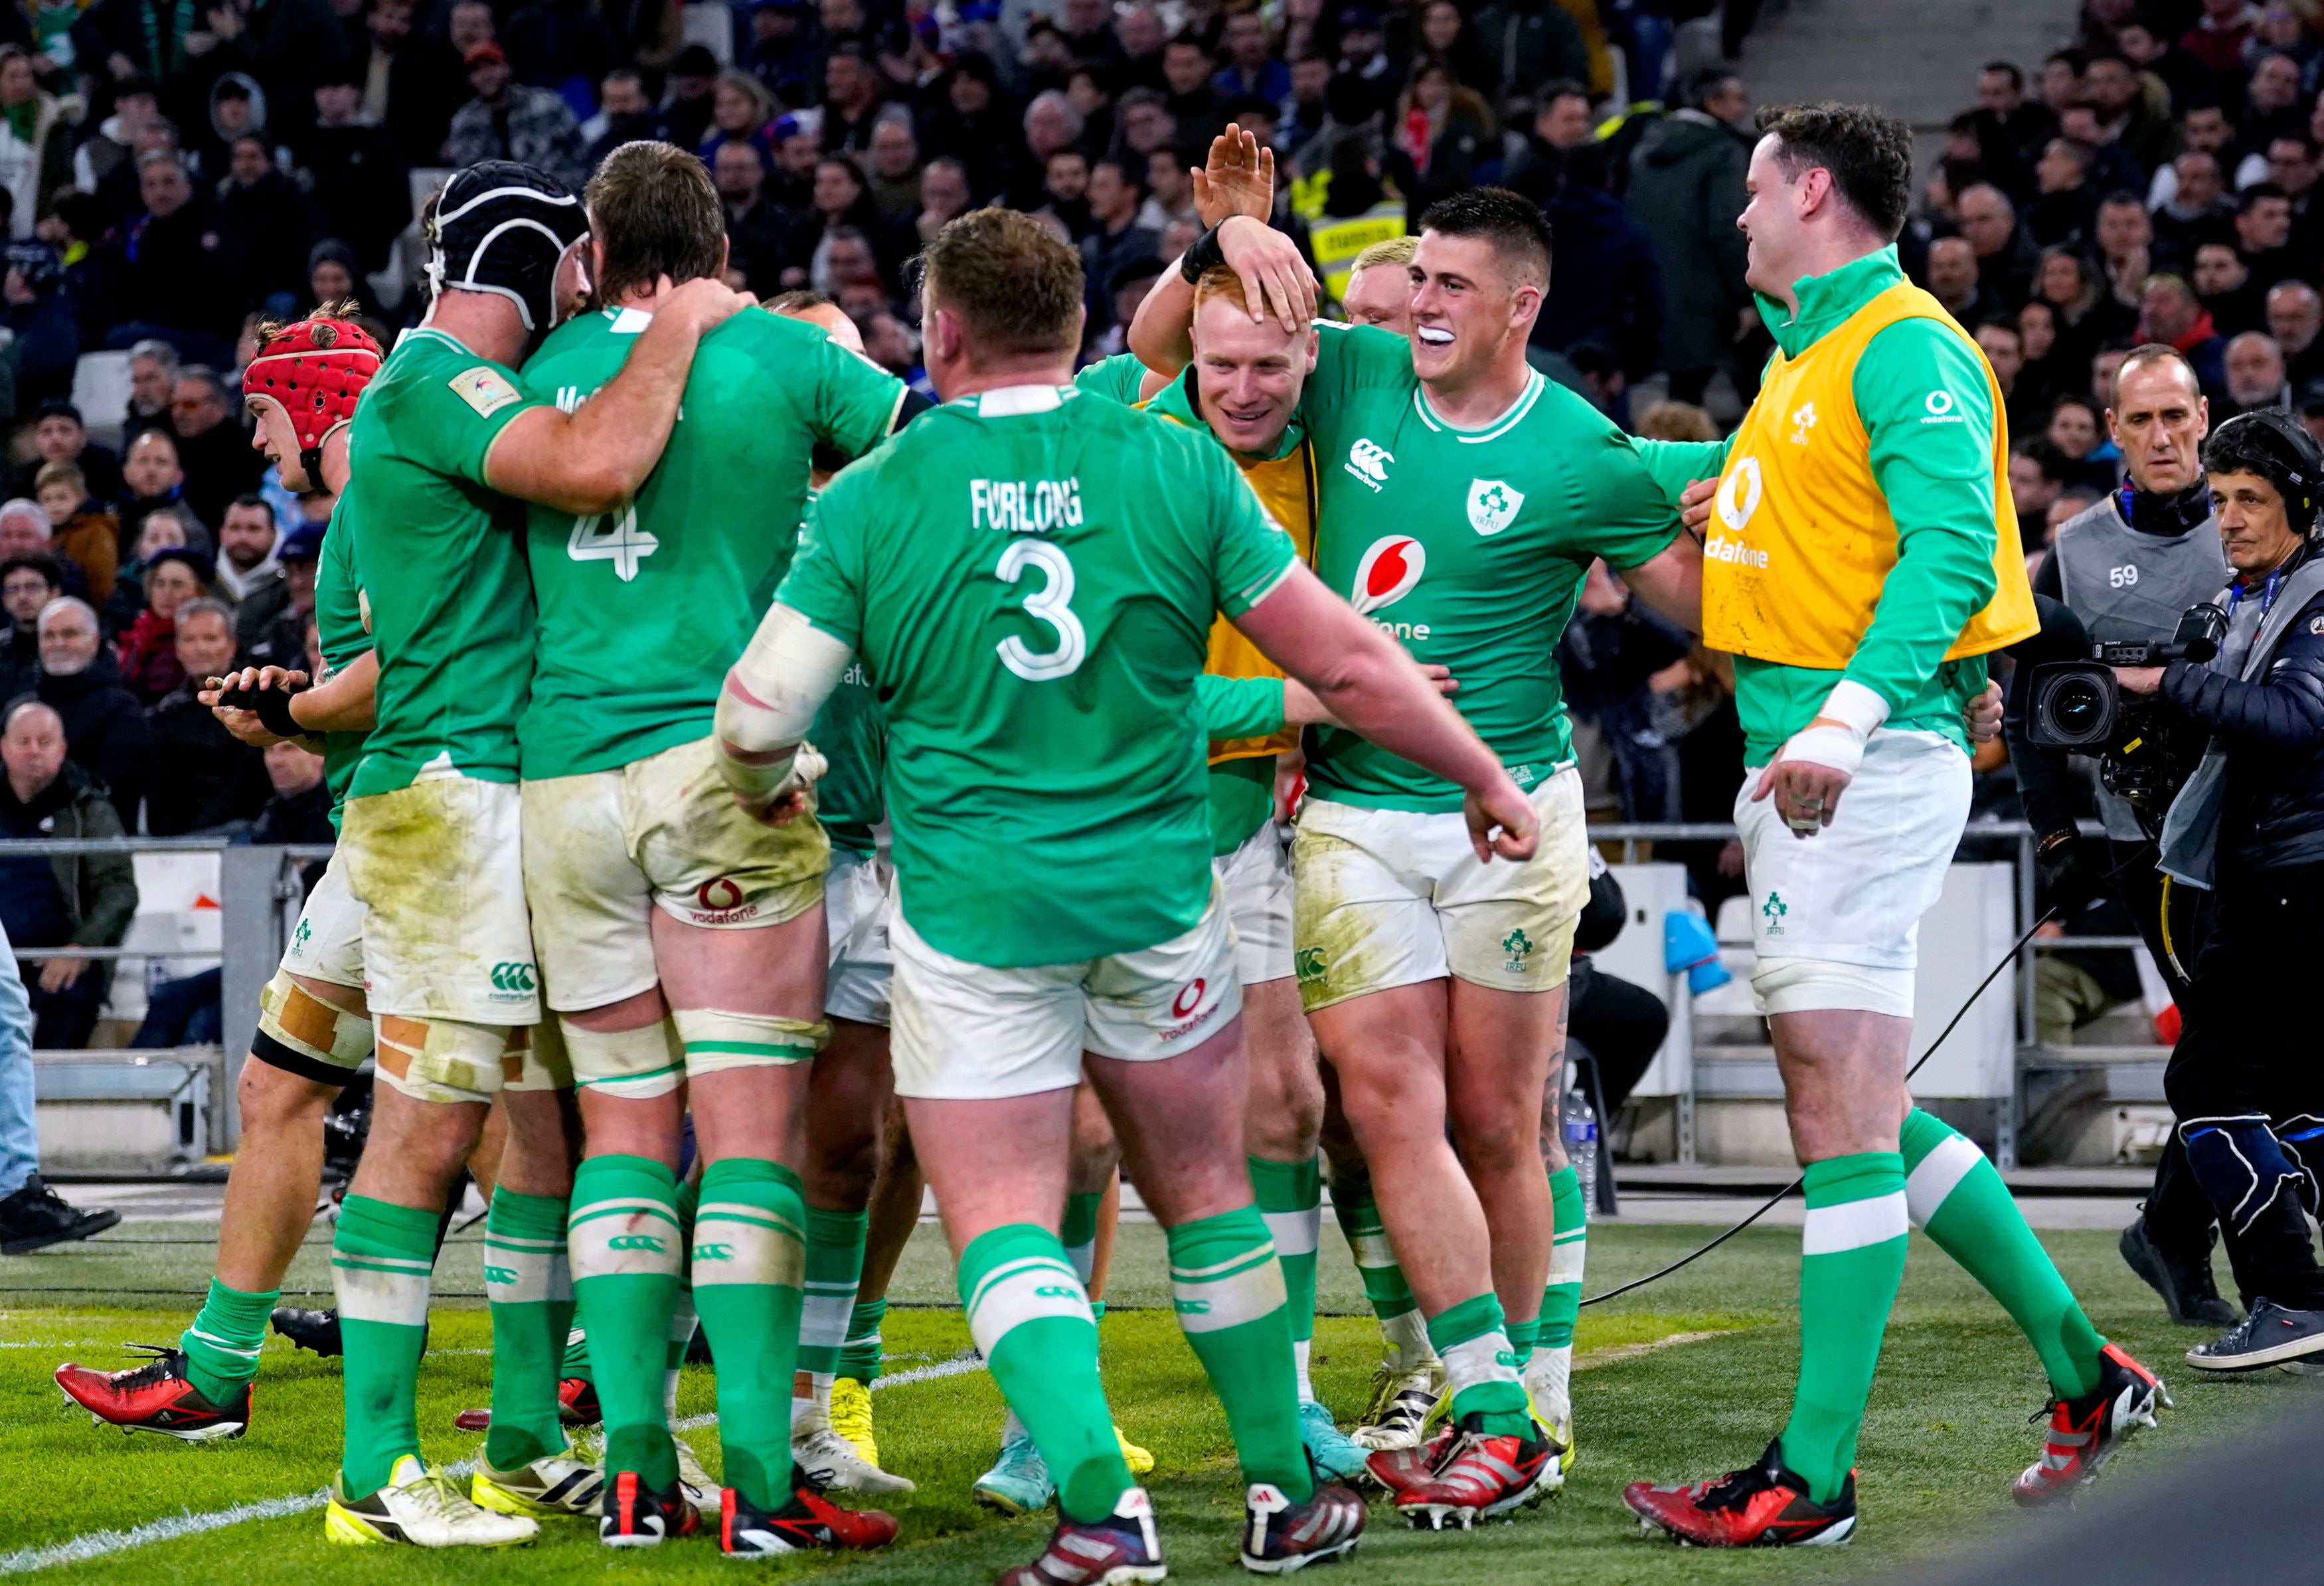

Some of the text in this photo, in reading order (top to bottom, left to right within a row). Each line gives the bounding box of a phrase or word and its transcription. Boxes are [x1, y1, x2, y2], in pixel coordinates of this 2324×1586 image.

[1920, 415, 1963, 424] vodafone
[1790, 434, 1809, 445] IRFU
[1344, 462, 1382, 493] canterbury
[970, 476, 1084, 532] FURLONG
[1475, 515, 1499, 529] IRFU
[567, 503, 659, 583] 4
[1704, 535, 1769, 569] dafone
[2110, 564, 2138, 588] 59
[995, 538, 1086, 681] 3
[690, 905, 758, 924] vodafone
[1767, 926, 1785, 936] IRFU
[1505, 962, 1527, 972] IRFU
